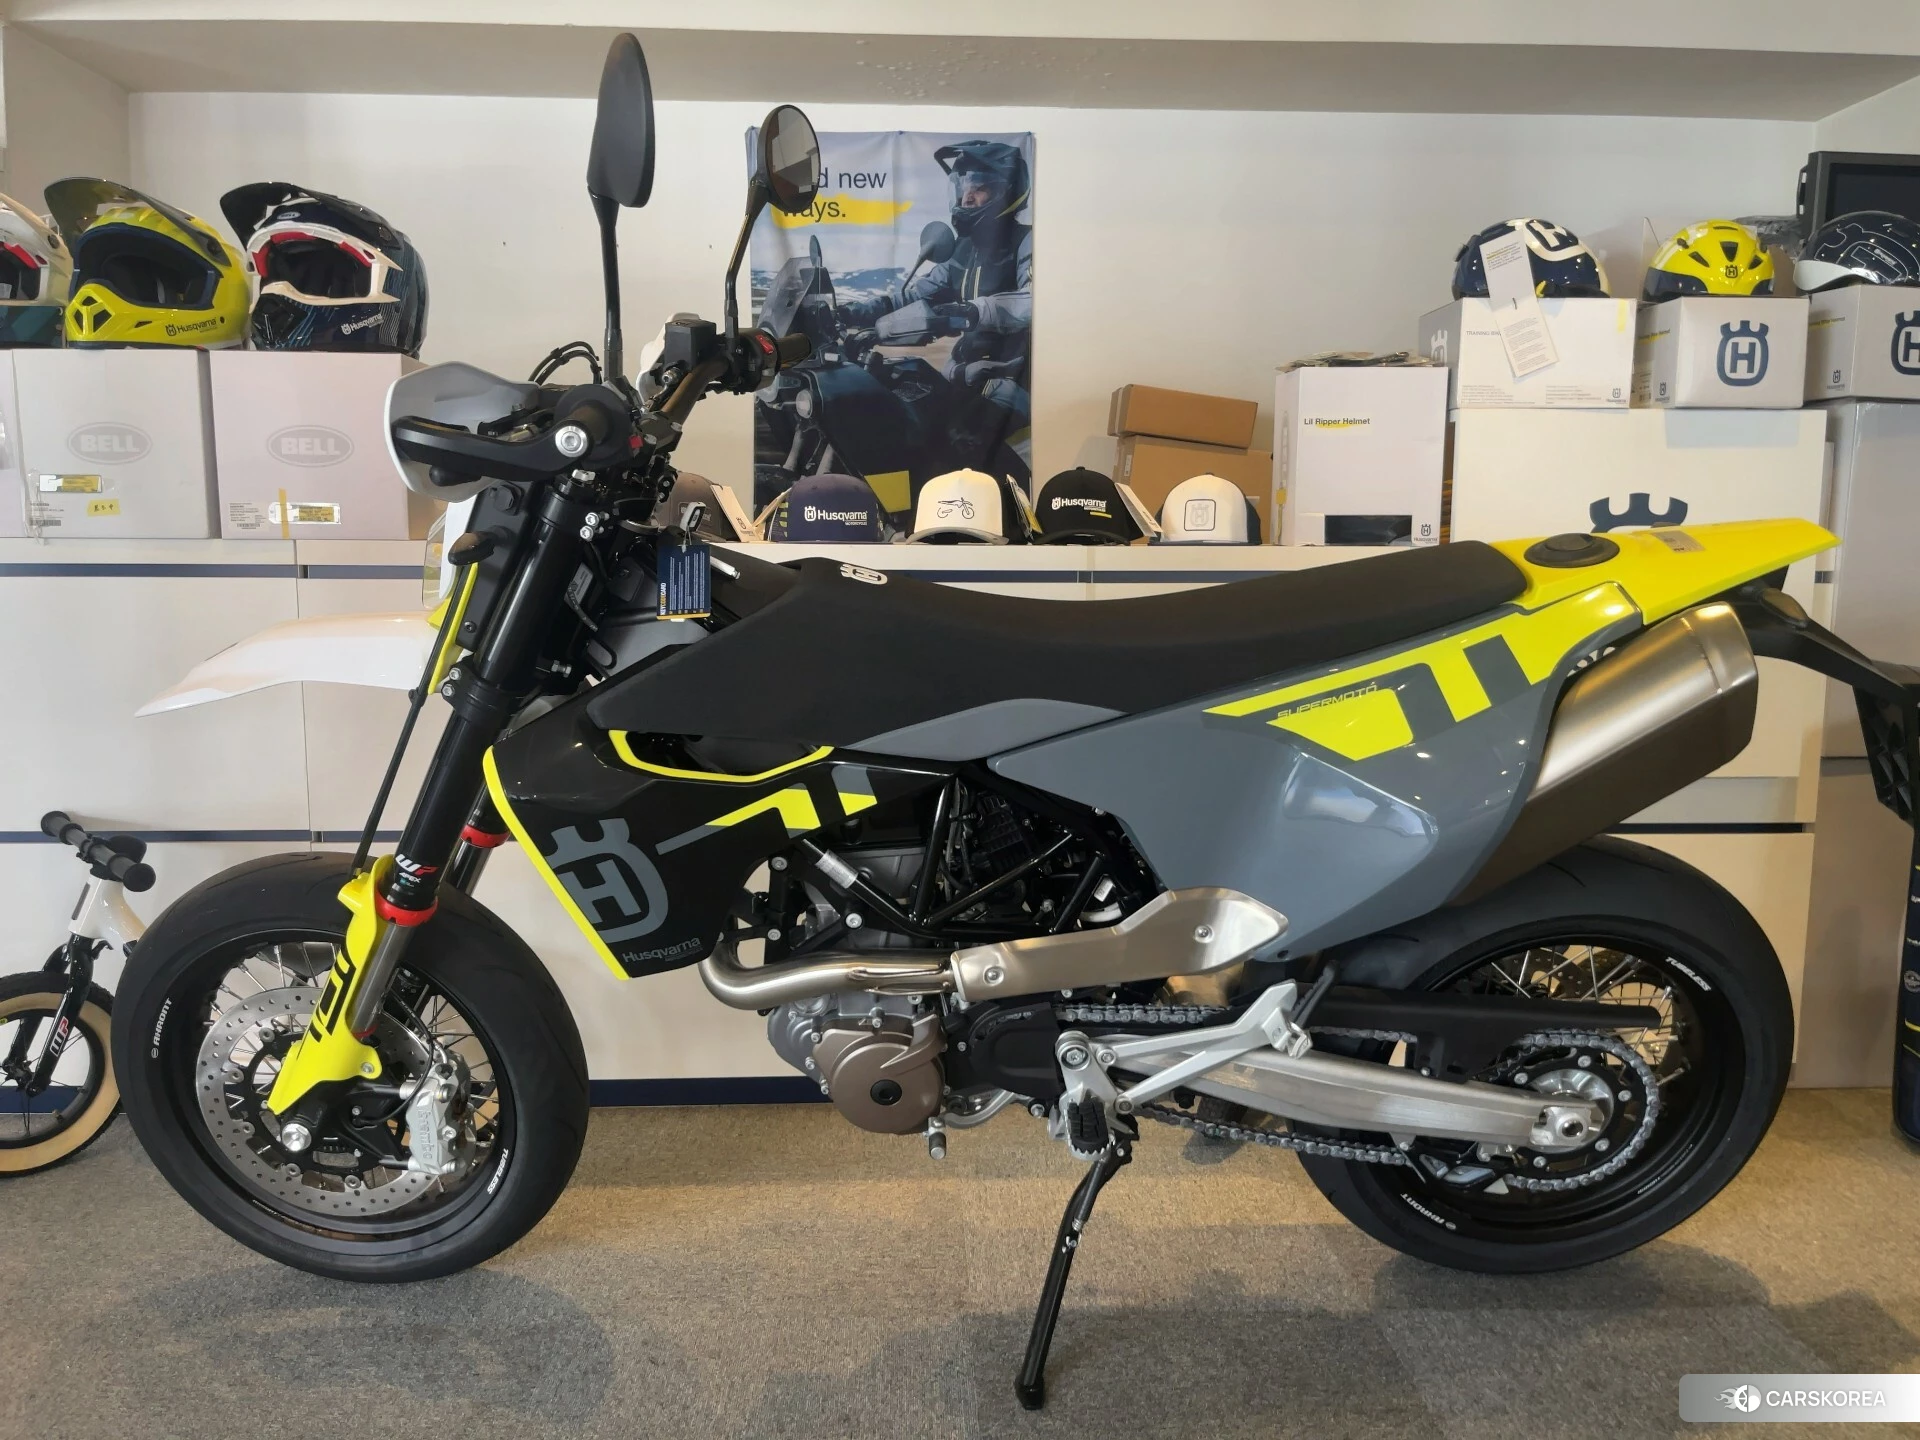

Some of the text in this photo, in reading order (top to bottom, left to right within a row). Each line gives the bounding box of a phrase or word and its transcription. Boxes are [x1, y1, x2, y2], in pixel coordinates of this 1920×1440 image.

[838, 172, 887, 189] new
[782, 200, 847, 223] ays.
[177, 318, 217, 334] Husqvarna
[350, 313, 383, 332] Husqvarna
[1315, 418, 1341, 427] Ripper
[1342, 417, 1371, 425] Helmet
[80, 434, 140, 452] BELL
[280, 437, 341, 456] BELL
[1061, 498, 1107, 509] Husqvarna
[817, 509, 868, 522] Husqvarna
[1277, 683, 1378, 719] SUPERMOTO
[395, 853, 440, 876] WP
[621, 937, 701, 963] Husqvarna
